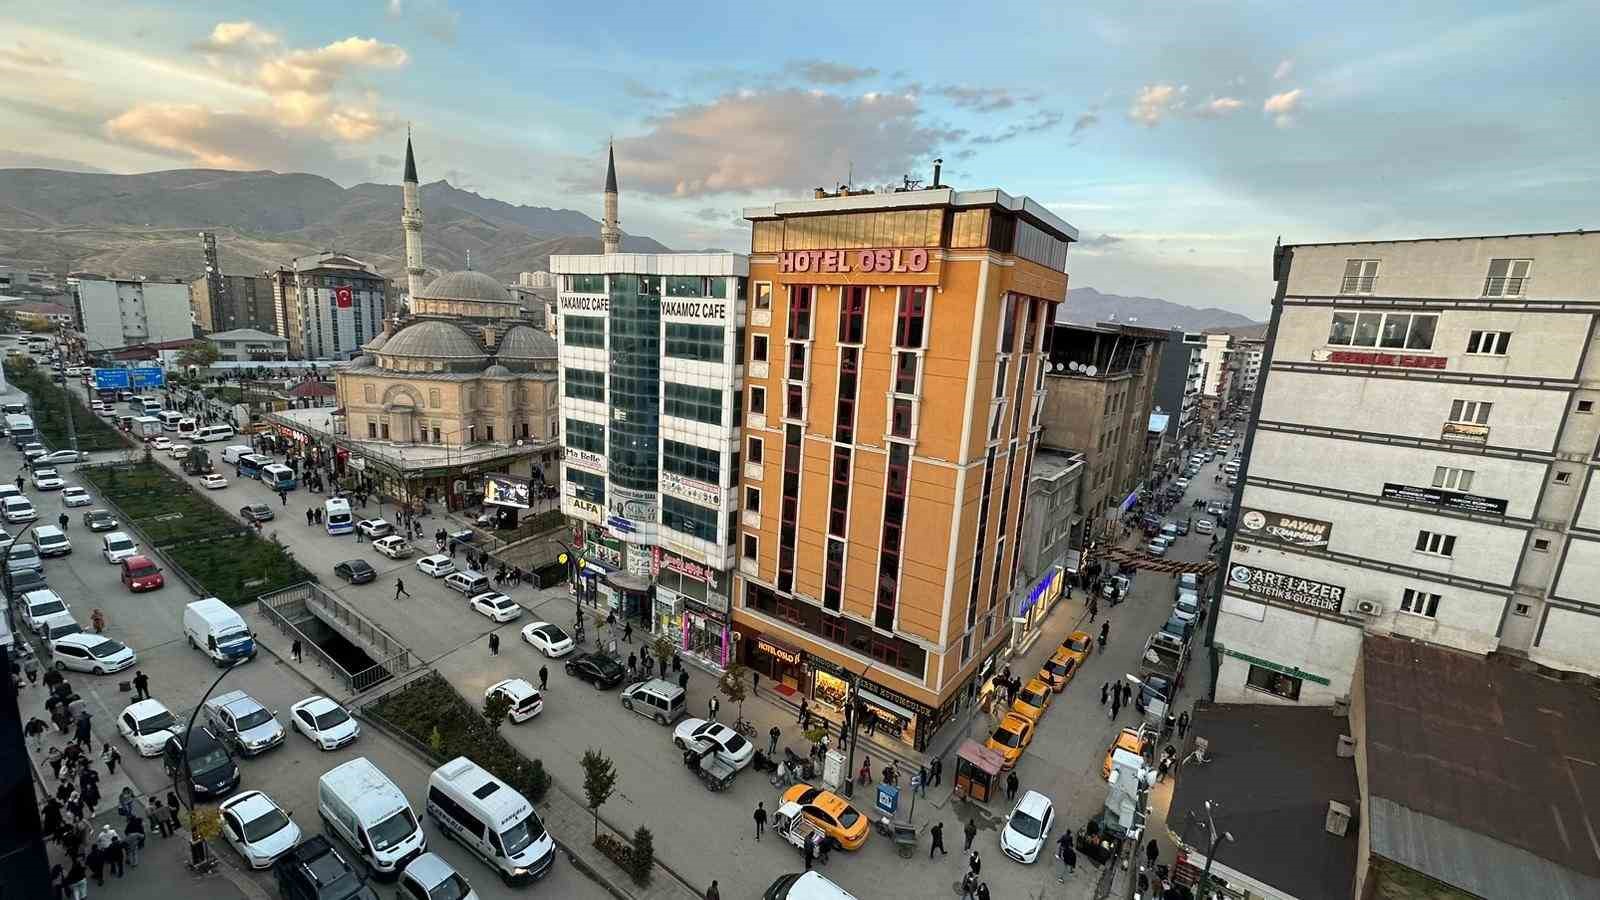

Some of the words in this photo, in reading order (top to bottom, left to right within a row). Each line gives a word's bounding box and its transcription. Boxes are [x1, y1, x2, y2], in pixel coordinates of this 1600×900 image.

[780, 251, 852, 273] HOTEL
[857, 248, 929, 273] OSLO
[560, 296, 591, 311] YAKAMOZ
[591, 297, 609, 312] CAFE
[661, 301, 701, 318] YAKAMOZ
[702, 303, 725, 319] CAFE
[566, 448, 578, 458] Ma
[580, 451, 601, 464] Belle
[574, 499, 598, 514] ALFA
[1280, 518, 1326, 534] BAYAN
[1253, 569, 1285, 586] ART
[1287, 577, 1342, 600] LAZER
[758, 640, 777, 656] HOTEL
[776, 649, 794, 663] OSLO
